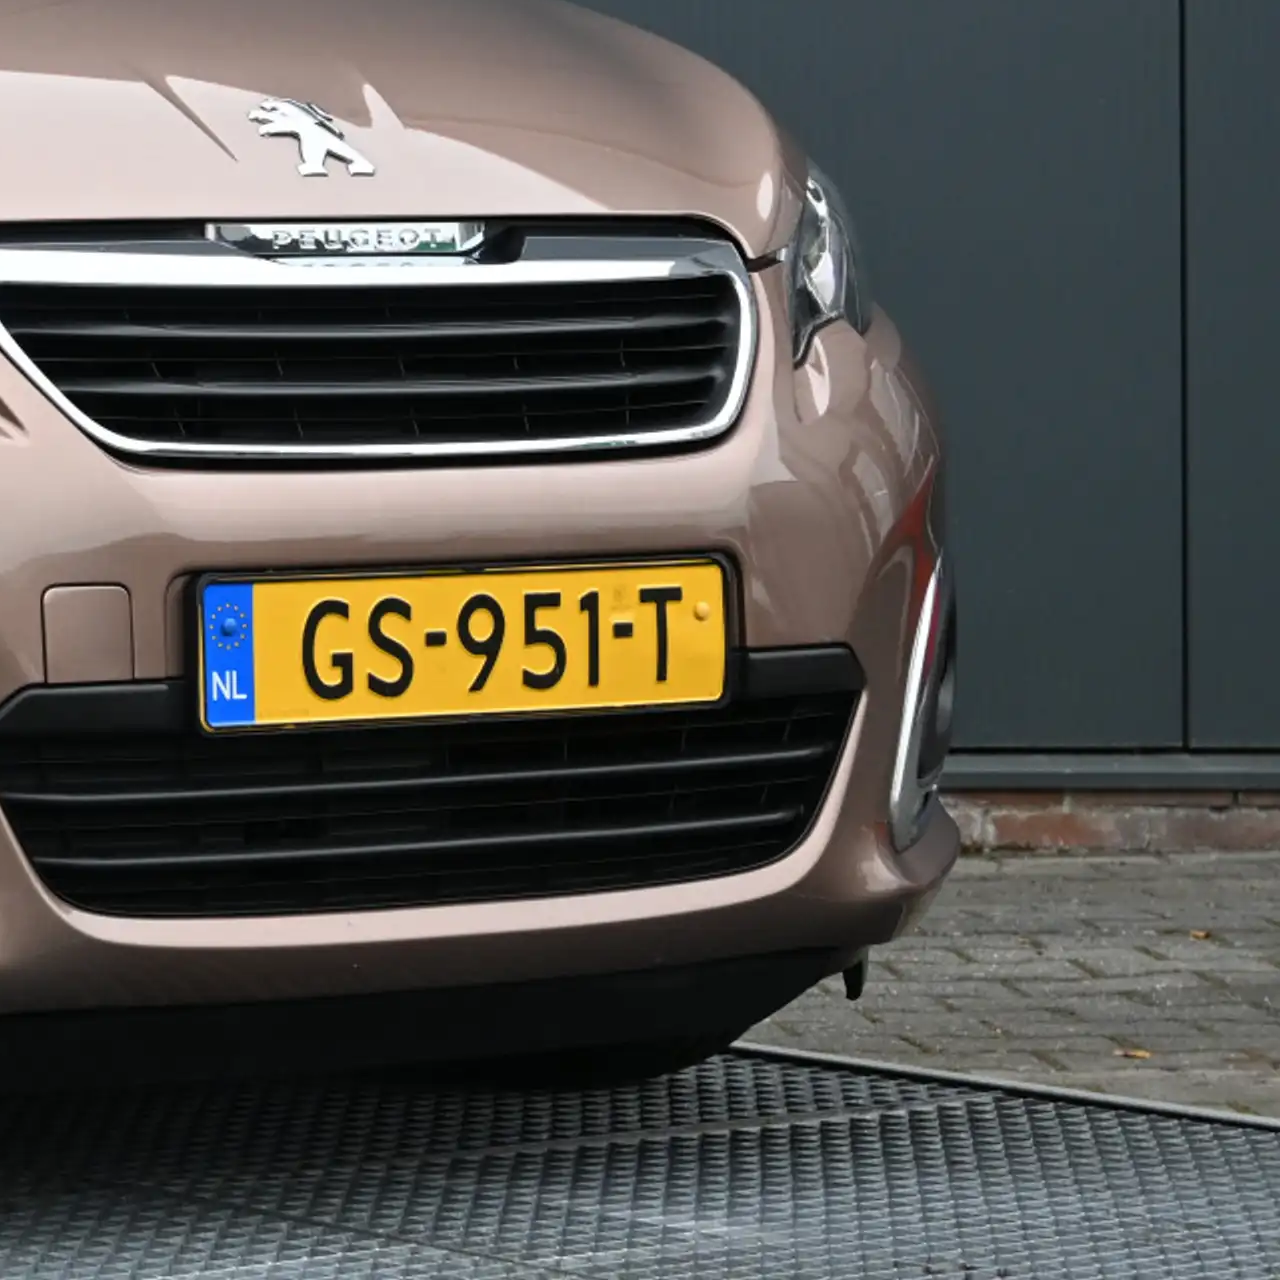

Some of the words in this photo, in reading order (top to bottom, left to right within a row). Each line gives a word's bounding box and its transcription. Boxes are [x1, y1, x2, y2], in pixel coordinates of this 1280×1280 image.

[271, 227, 443, 252] PEUGEOT
[301, 586, 683, 701] GS-951-T
[211, 670, 248, 702] NL
